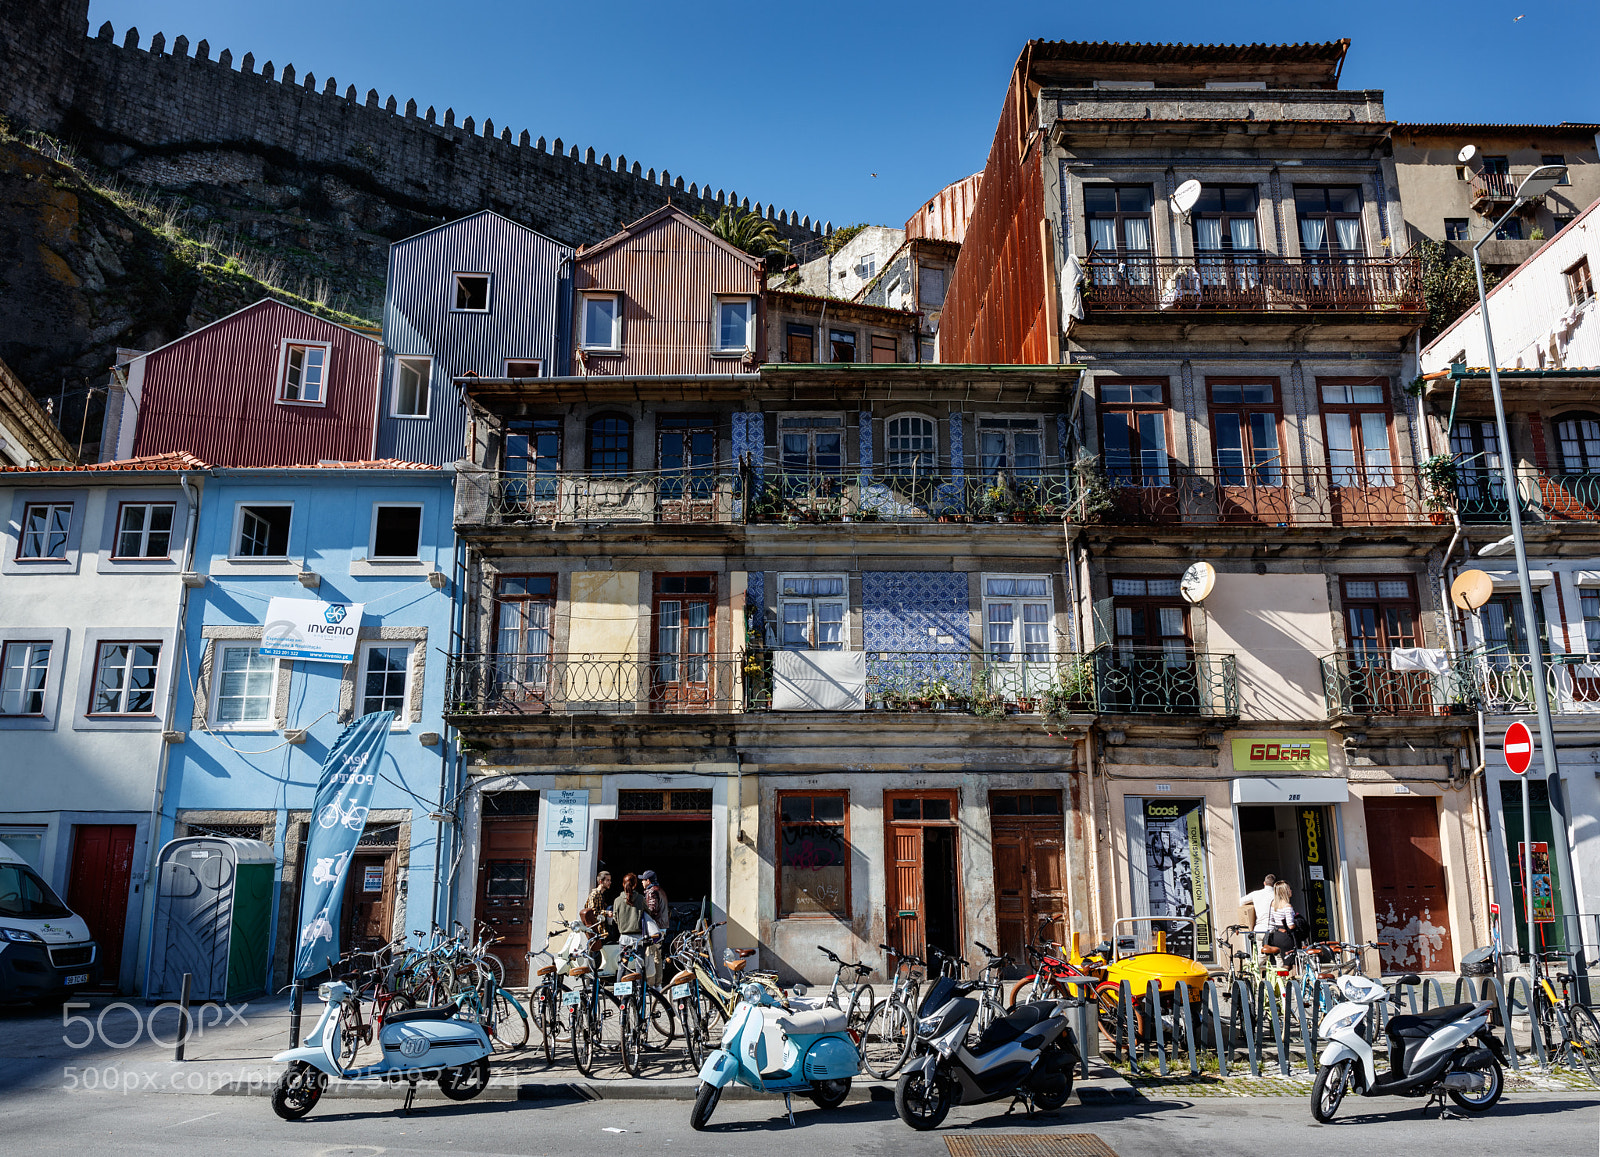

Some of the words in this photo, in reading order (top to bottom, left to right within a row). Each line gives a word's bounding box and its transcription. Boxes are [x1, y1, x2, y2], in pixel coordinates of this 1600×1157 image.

[307, 624, 354, 636] invenio
[1148, 805, 1179, 816] boost
[1302, 810, 1320, 863] boost
[406, 1036, 424, 1054] 50
